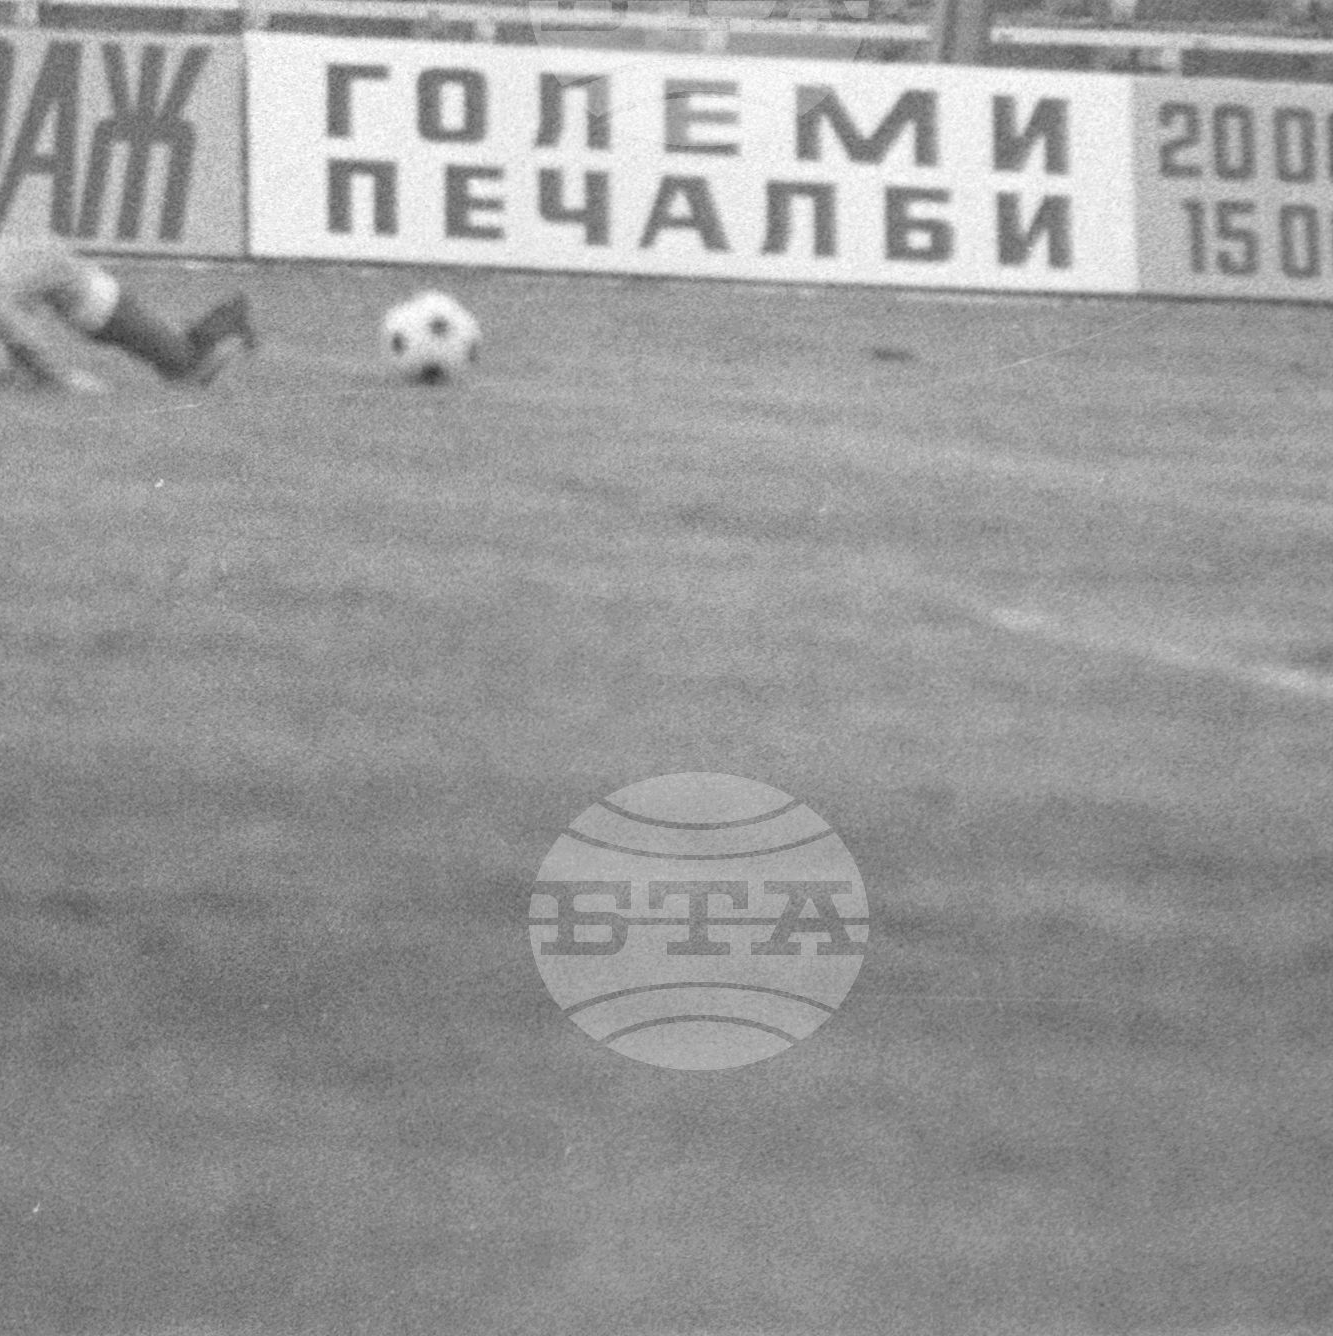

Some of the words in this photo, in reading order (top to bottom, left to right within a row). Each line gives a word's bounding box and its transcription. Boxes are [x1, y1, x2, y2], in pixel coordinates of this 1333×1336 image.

[327, 64, 1069, 175] ГОЛЕМИ
[1158, 101, 1333, 184] 200
[327, 158, 1073, 269] ПЕЧАЛБИ
[1181, 199, 1333, 280] 150
